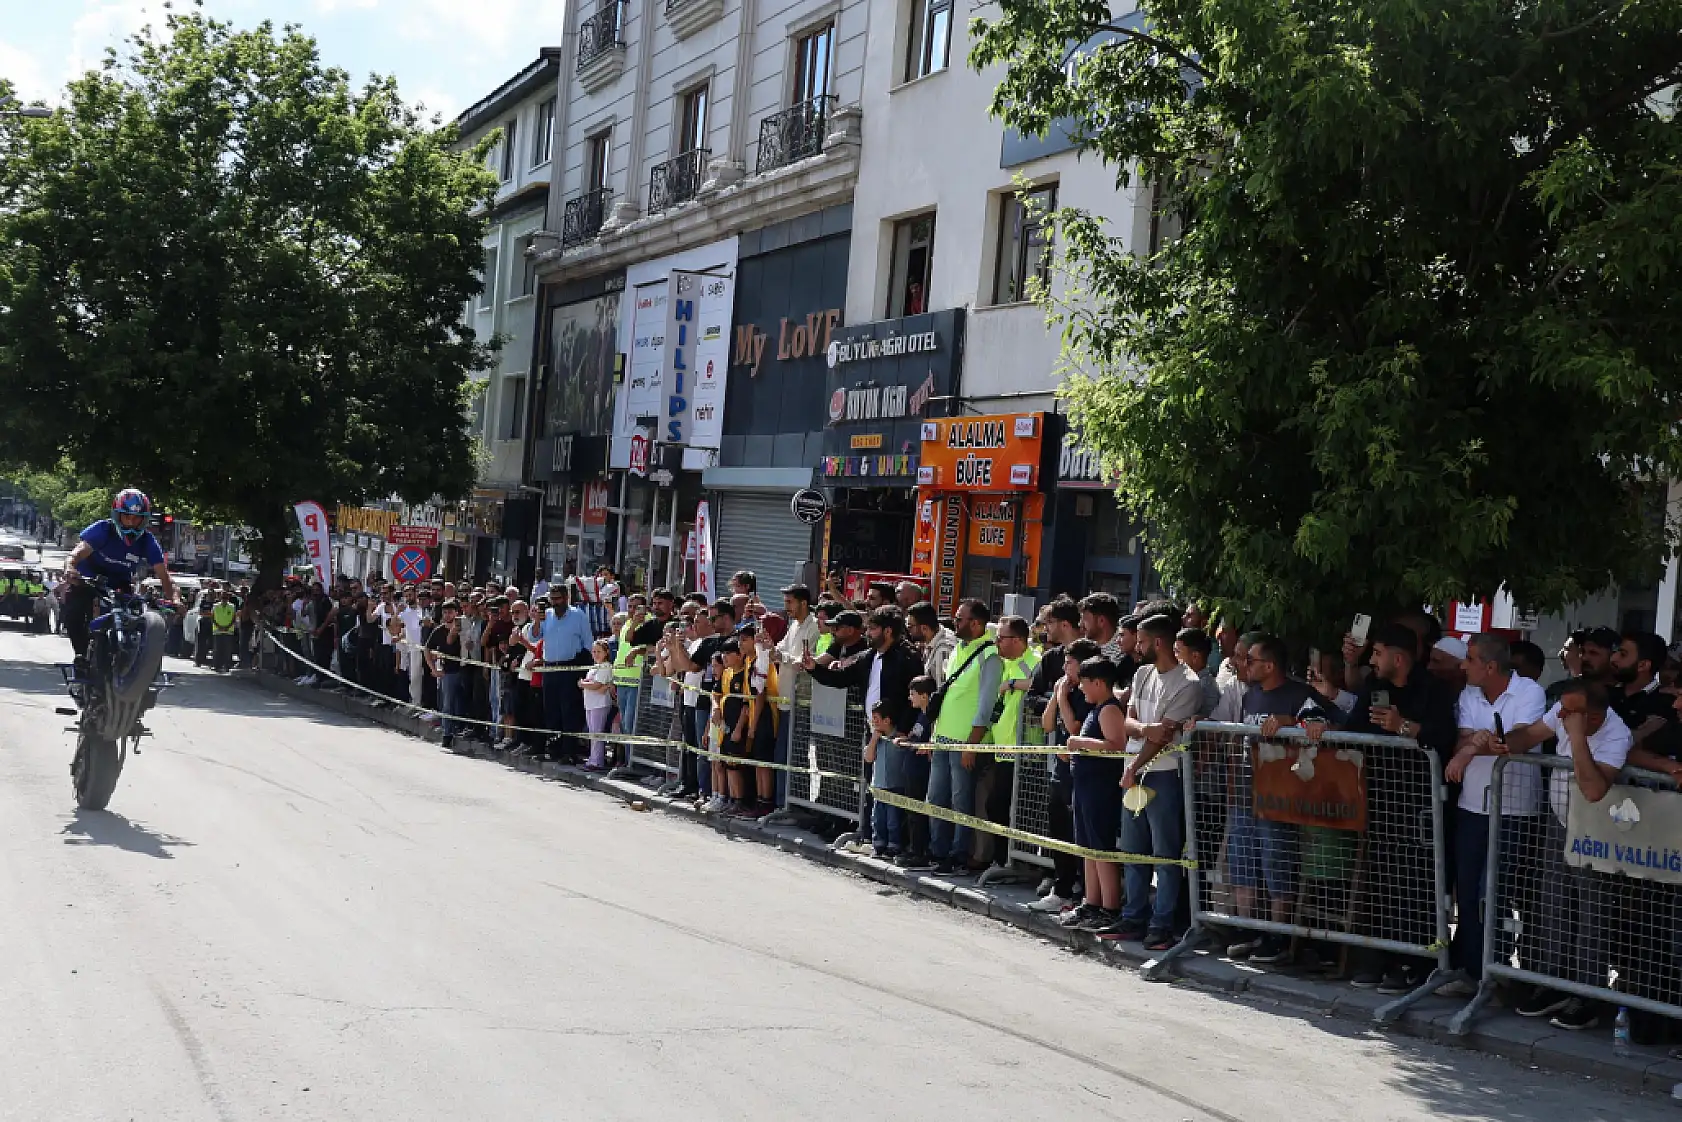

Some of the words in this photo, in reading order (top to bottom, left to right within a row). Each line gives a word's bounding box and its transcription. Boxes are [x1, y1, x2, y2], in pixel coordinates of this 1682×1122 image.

[668, 274, 694, 442] PHILIPS
[733, 323, 767, 378] My
[838, 335, 880, 362] BÜYÜK
[908, 331, 937, 353] OTEL
[946, 420, 1006, 449] ALALMA
[955, 452, 993, 486] BÜFE
[975, 501, 1015, 521] ALALMA
[942, 495, 962, 569] BULUNUR
[979, 522, 1006, 547] BÜFE
[1571, 833, 1609, 859] AĞRI
